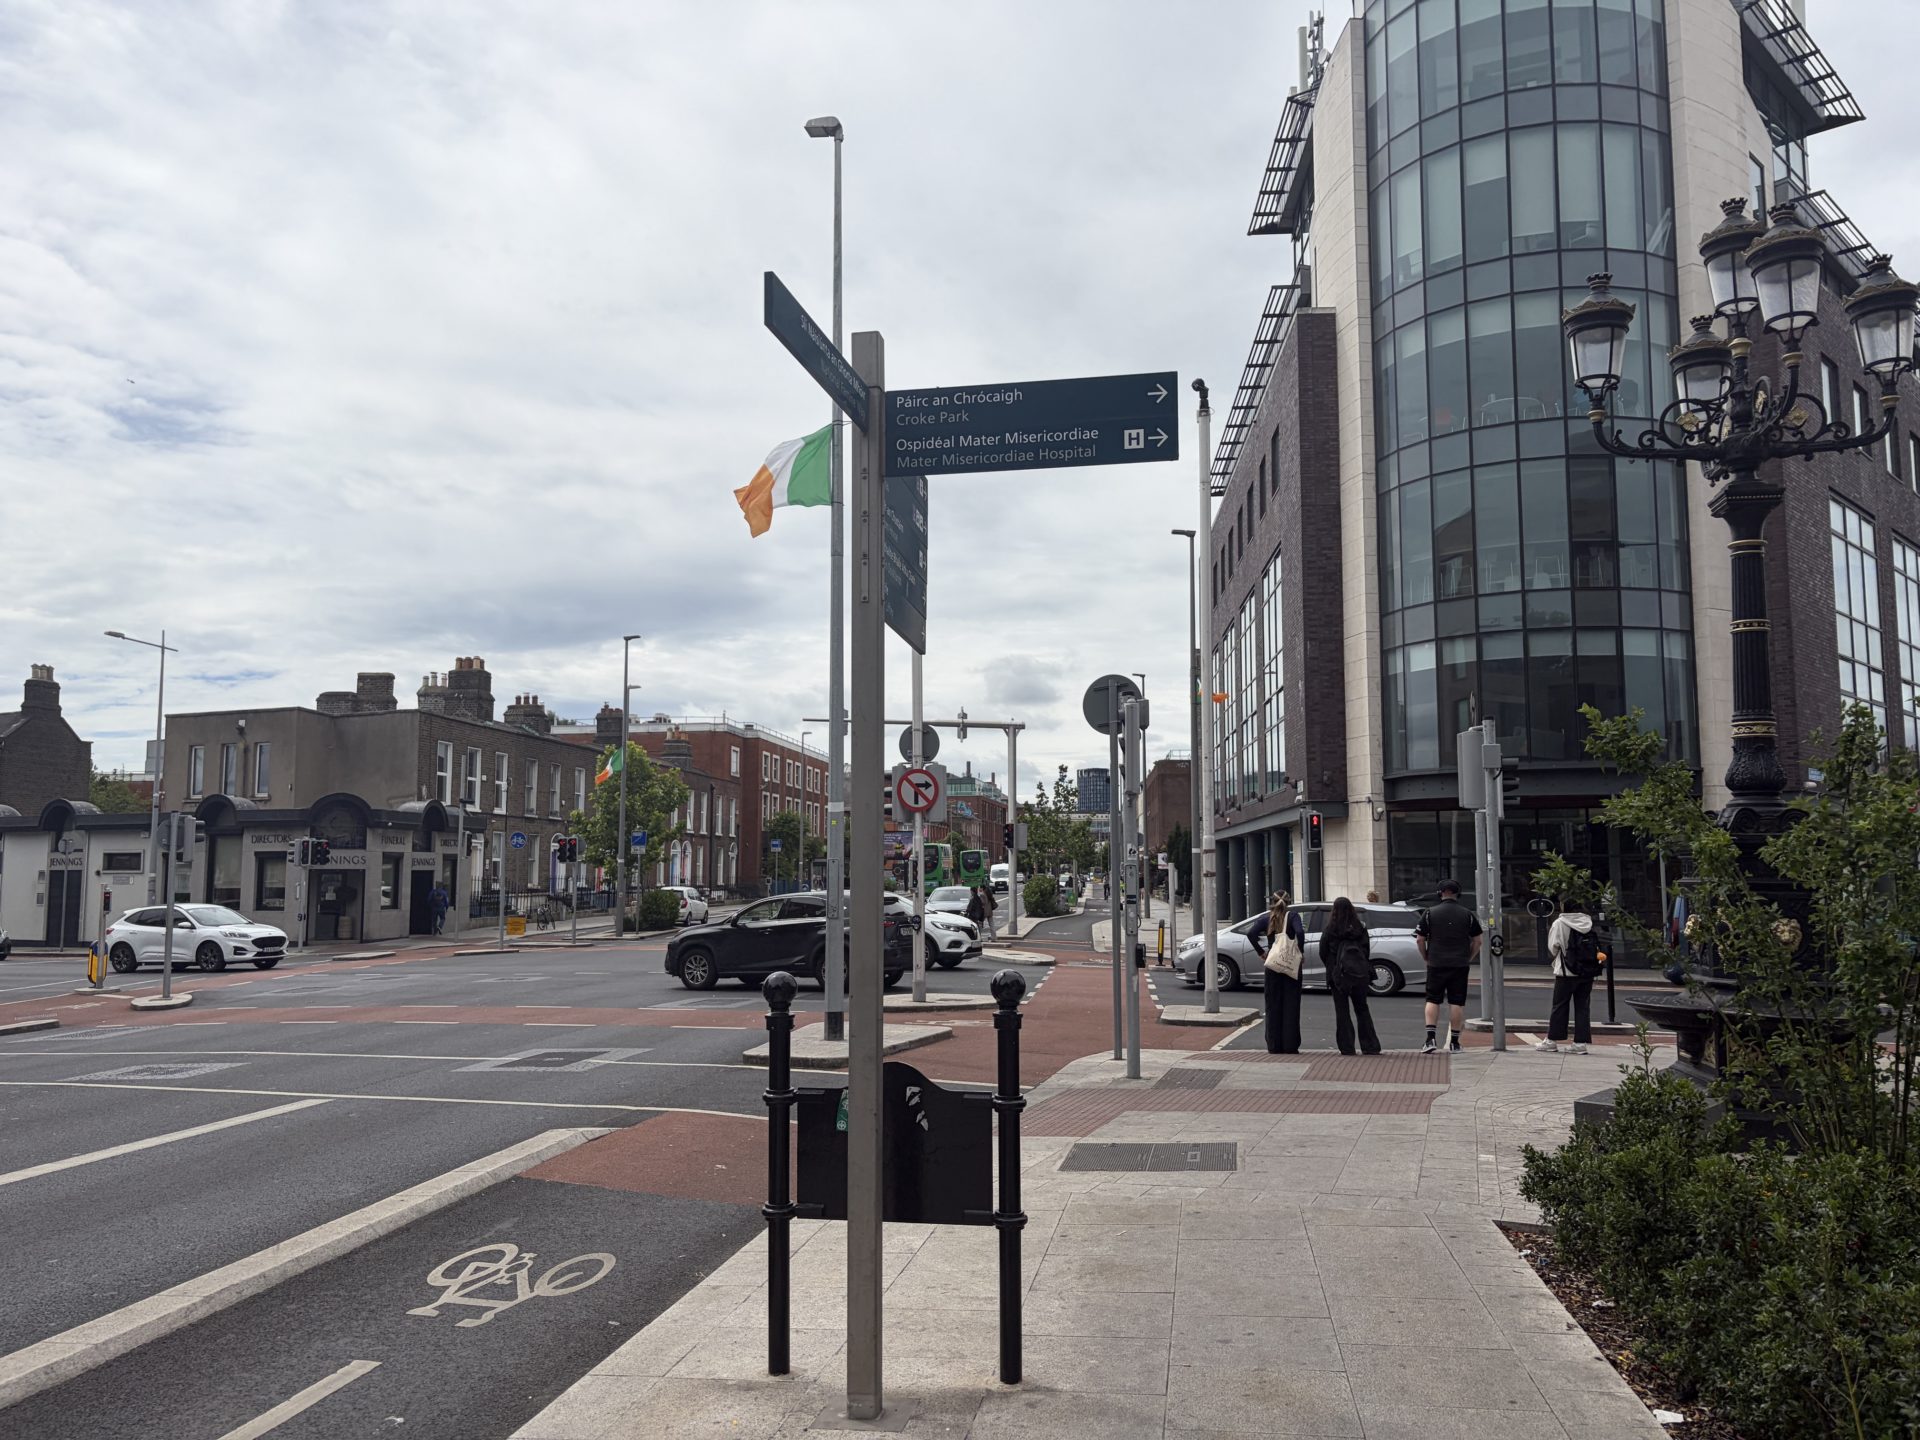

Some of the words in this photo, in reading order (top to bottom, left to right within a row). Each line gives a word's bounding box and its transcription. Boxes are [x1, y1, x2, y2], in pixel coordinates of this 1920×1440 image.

[896, 393, 929, 408] Páirc
[932, 396, 949, 406] an
[953, 388, 1024, 406] Chrócaigh
[896, 412, 936, 426] Croke
[940, 409, 970, 424] Park
[896, 435, 955, 452] Ospidéal
[959, 434, 1001, 448] Mater
[1005, 427, 1099, 445] Misericordiae
[1127, 431, 1141, 447] H
[896, 456, 939, 469] Mater
[942, 449, 1034, 467] Misericordiae
[1039, 444, 1096, 461] Hospital
[381, 834, 406, 846] FUNERAL
[50, 857, 83, 868] JENNNGS
[330, 855, 367, 865] NINGS
[411, 857, 436, 868] JENNINGS
